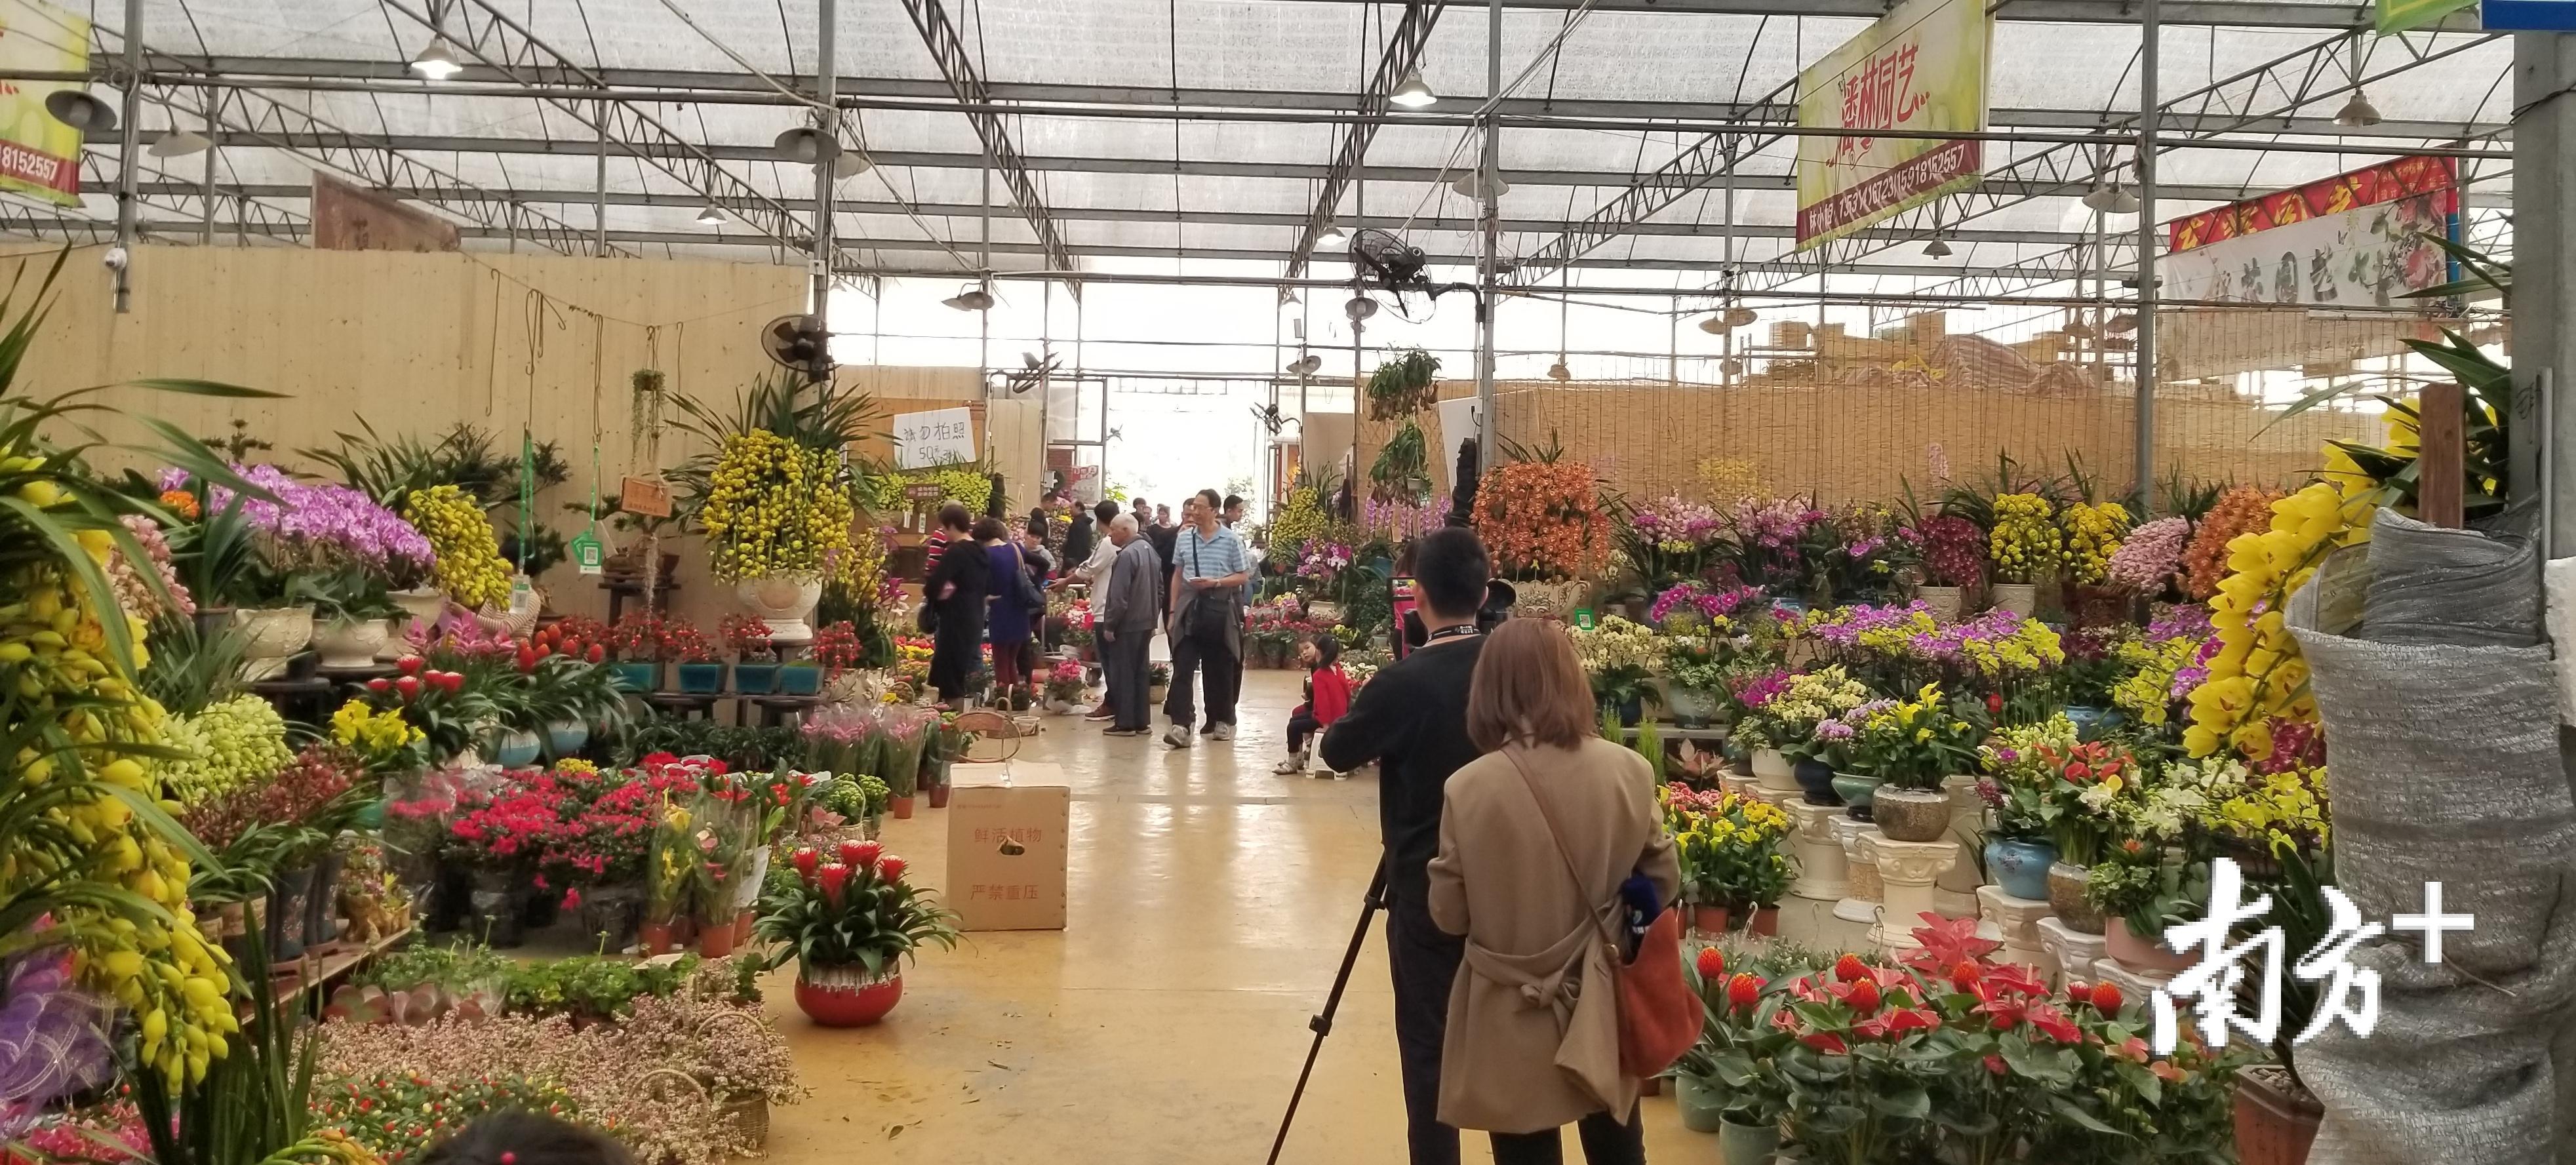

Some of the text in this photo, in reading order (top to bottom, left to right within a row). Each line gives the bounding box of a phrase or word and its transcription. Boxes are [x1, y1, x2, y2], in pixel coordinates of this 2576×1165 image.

[0, 144, 58, 181] 8152557
[974, 827, 1042, 842] 鲜活植物
[970, 884, 1039, 900] 严禁重压
